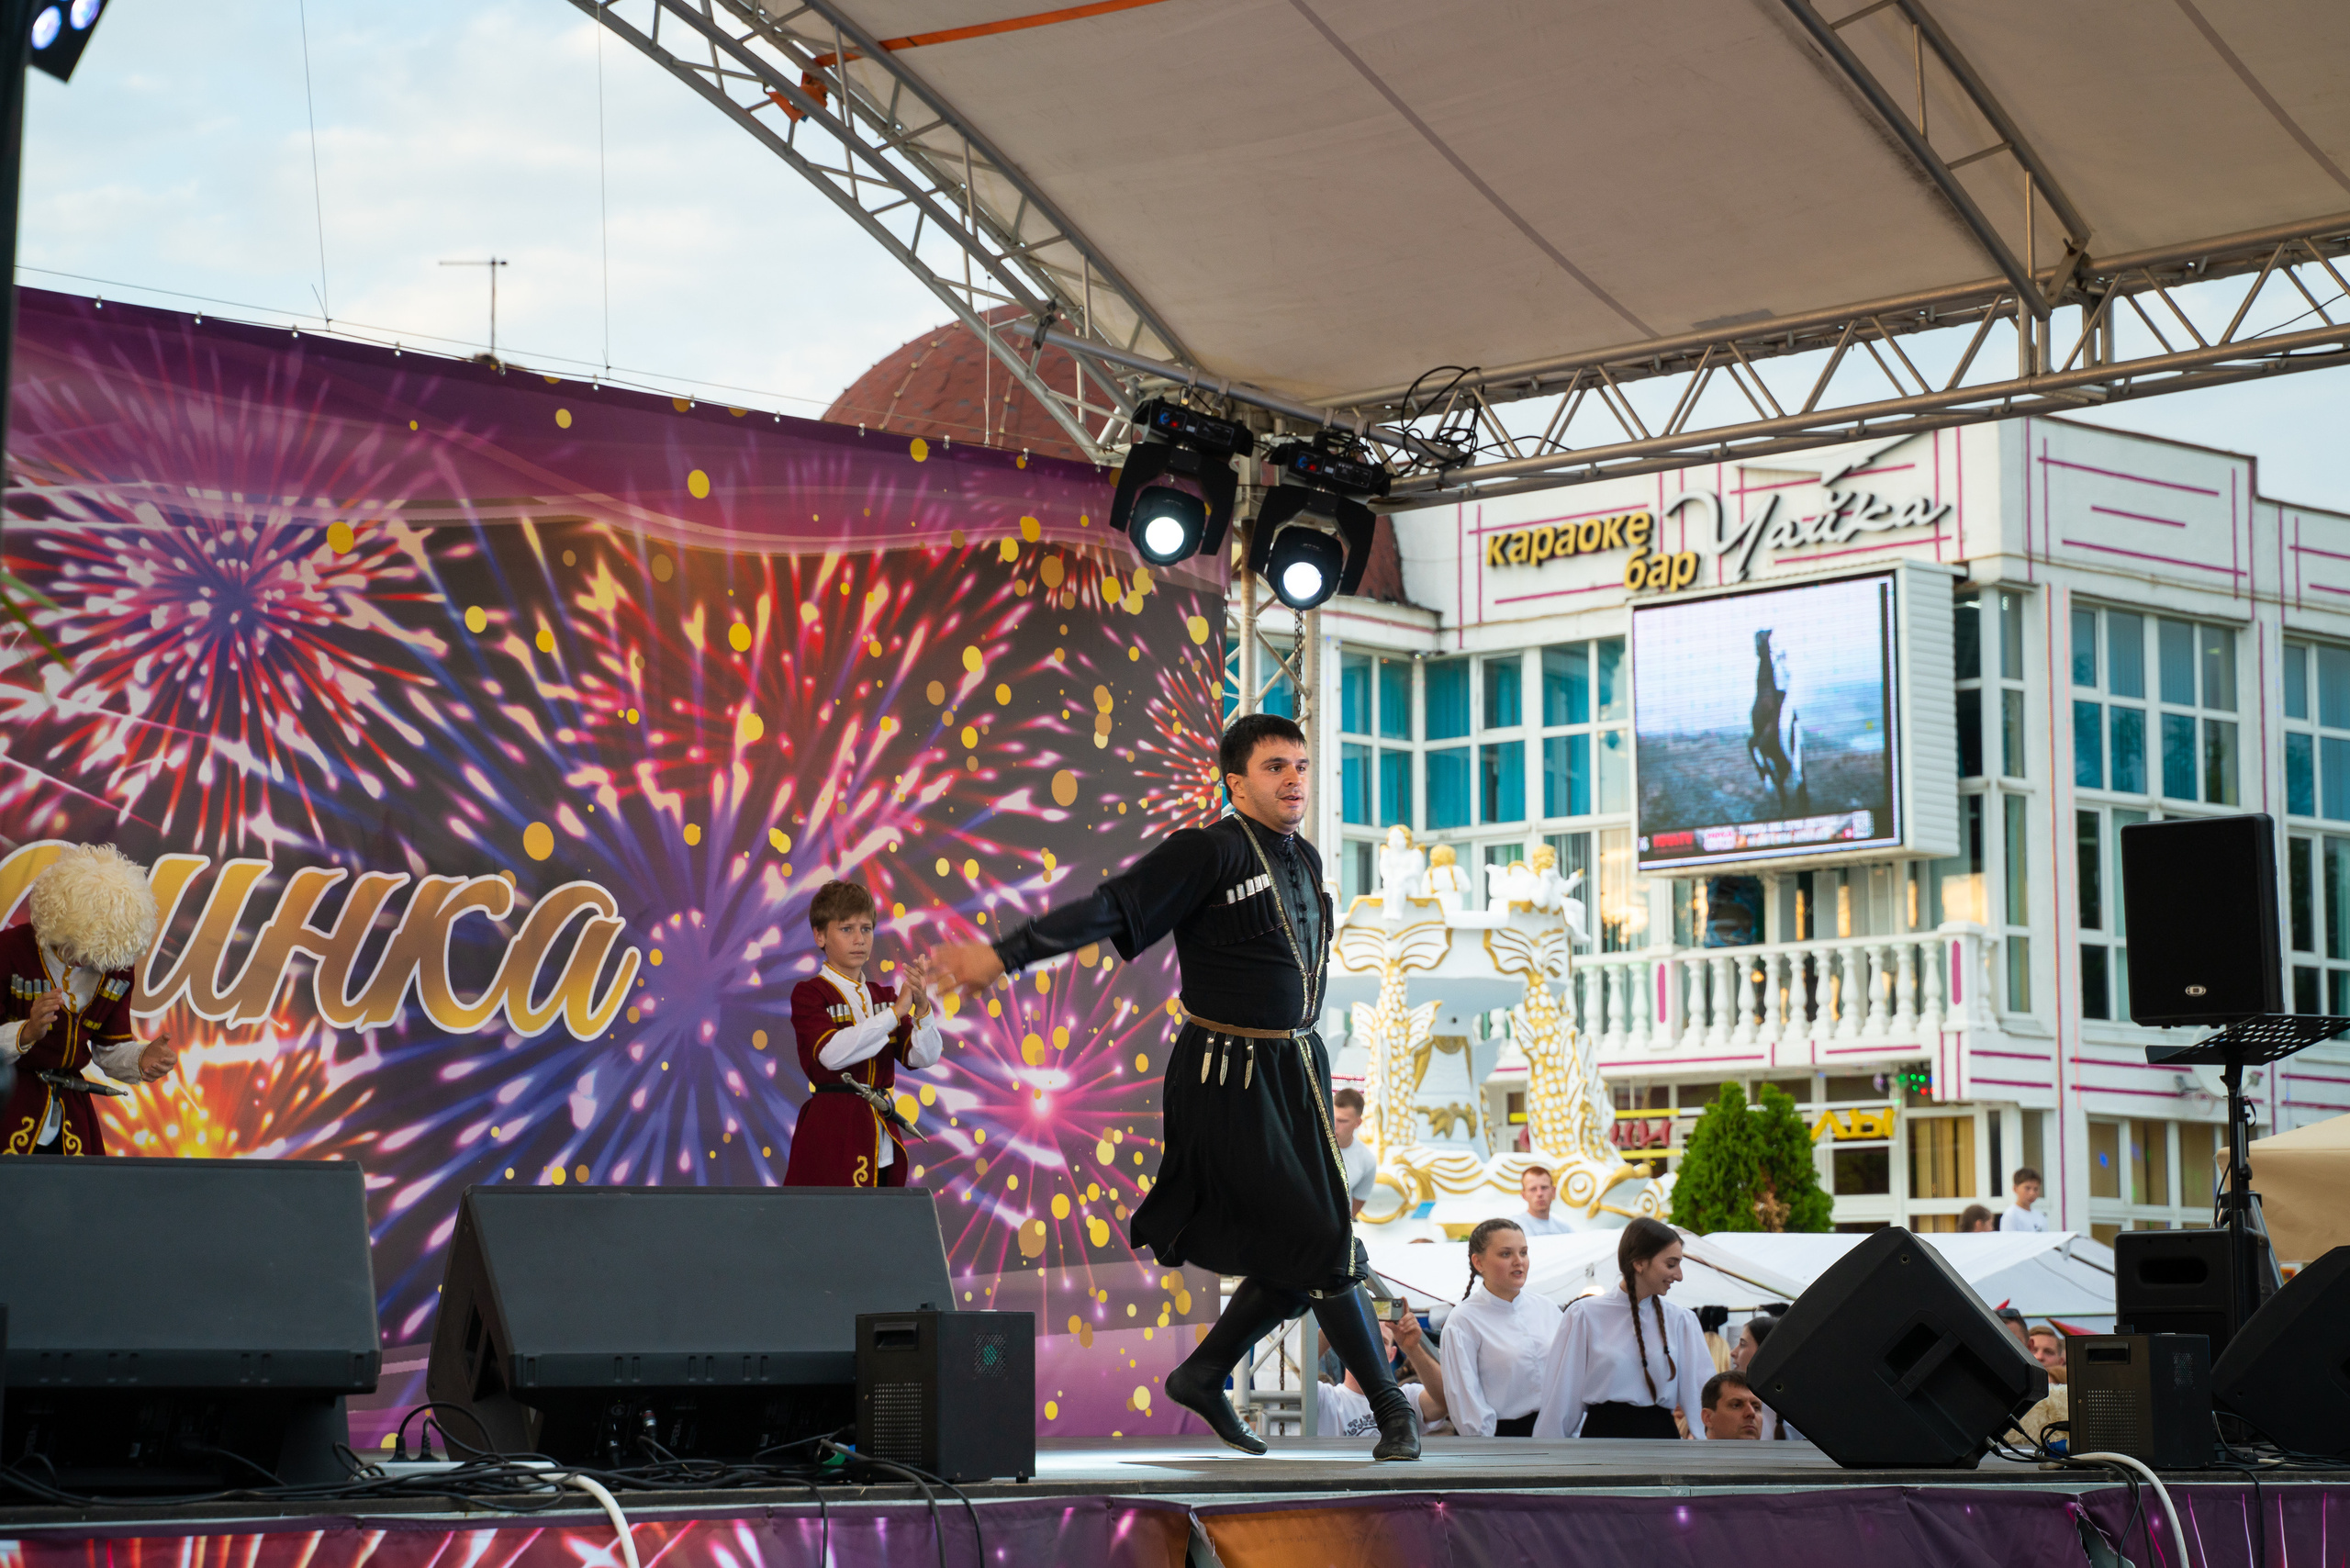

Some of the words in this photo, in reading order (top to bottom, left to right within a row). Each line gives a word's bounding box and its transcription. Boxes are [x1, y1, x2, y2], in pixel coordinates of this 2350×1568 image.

[1486, 511, 1653, 567] караоке
[1665, 488, 1951, 580] Чайка
[1623, 547, 1698, 591] бар
